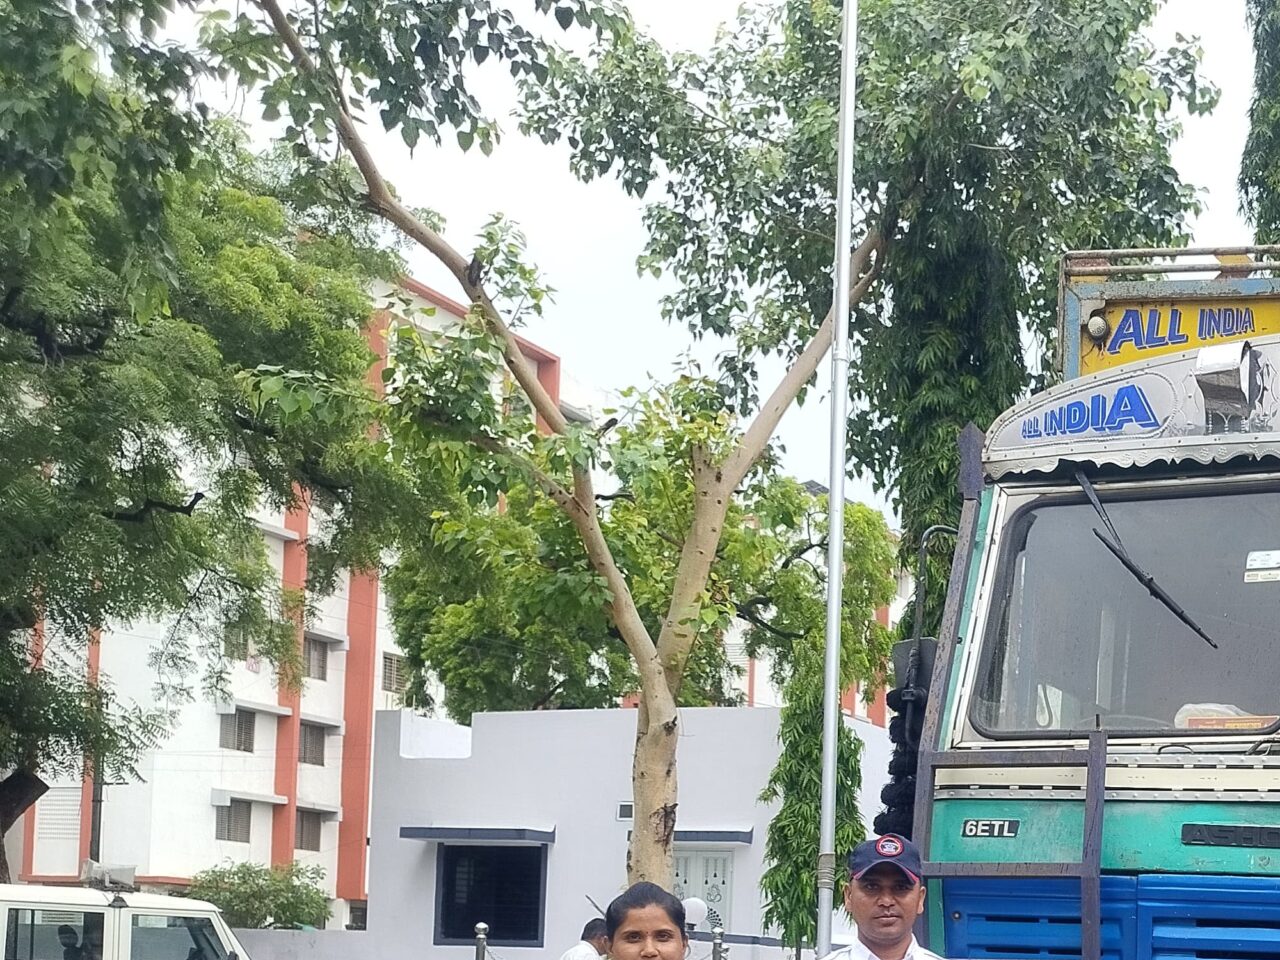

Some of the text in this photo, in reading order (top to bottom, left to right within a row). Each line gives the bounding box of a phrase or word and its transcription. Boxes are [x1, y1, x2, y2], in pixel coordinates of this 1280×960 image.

[1107, 307, 1256, 354] ALL INDIA
[1021, 383, 1161, 439] ALL INDIA
[963, 818, 1018, 838] 6ETL
